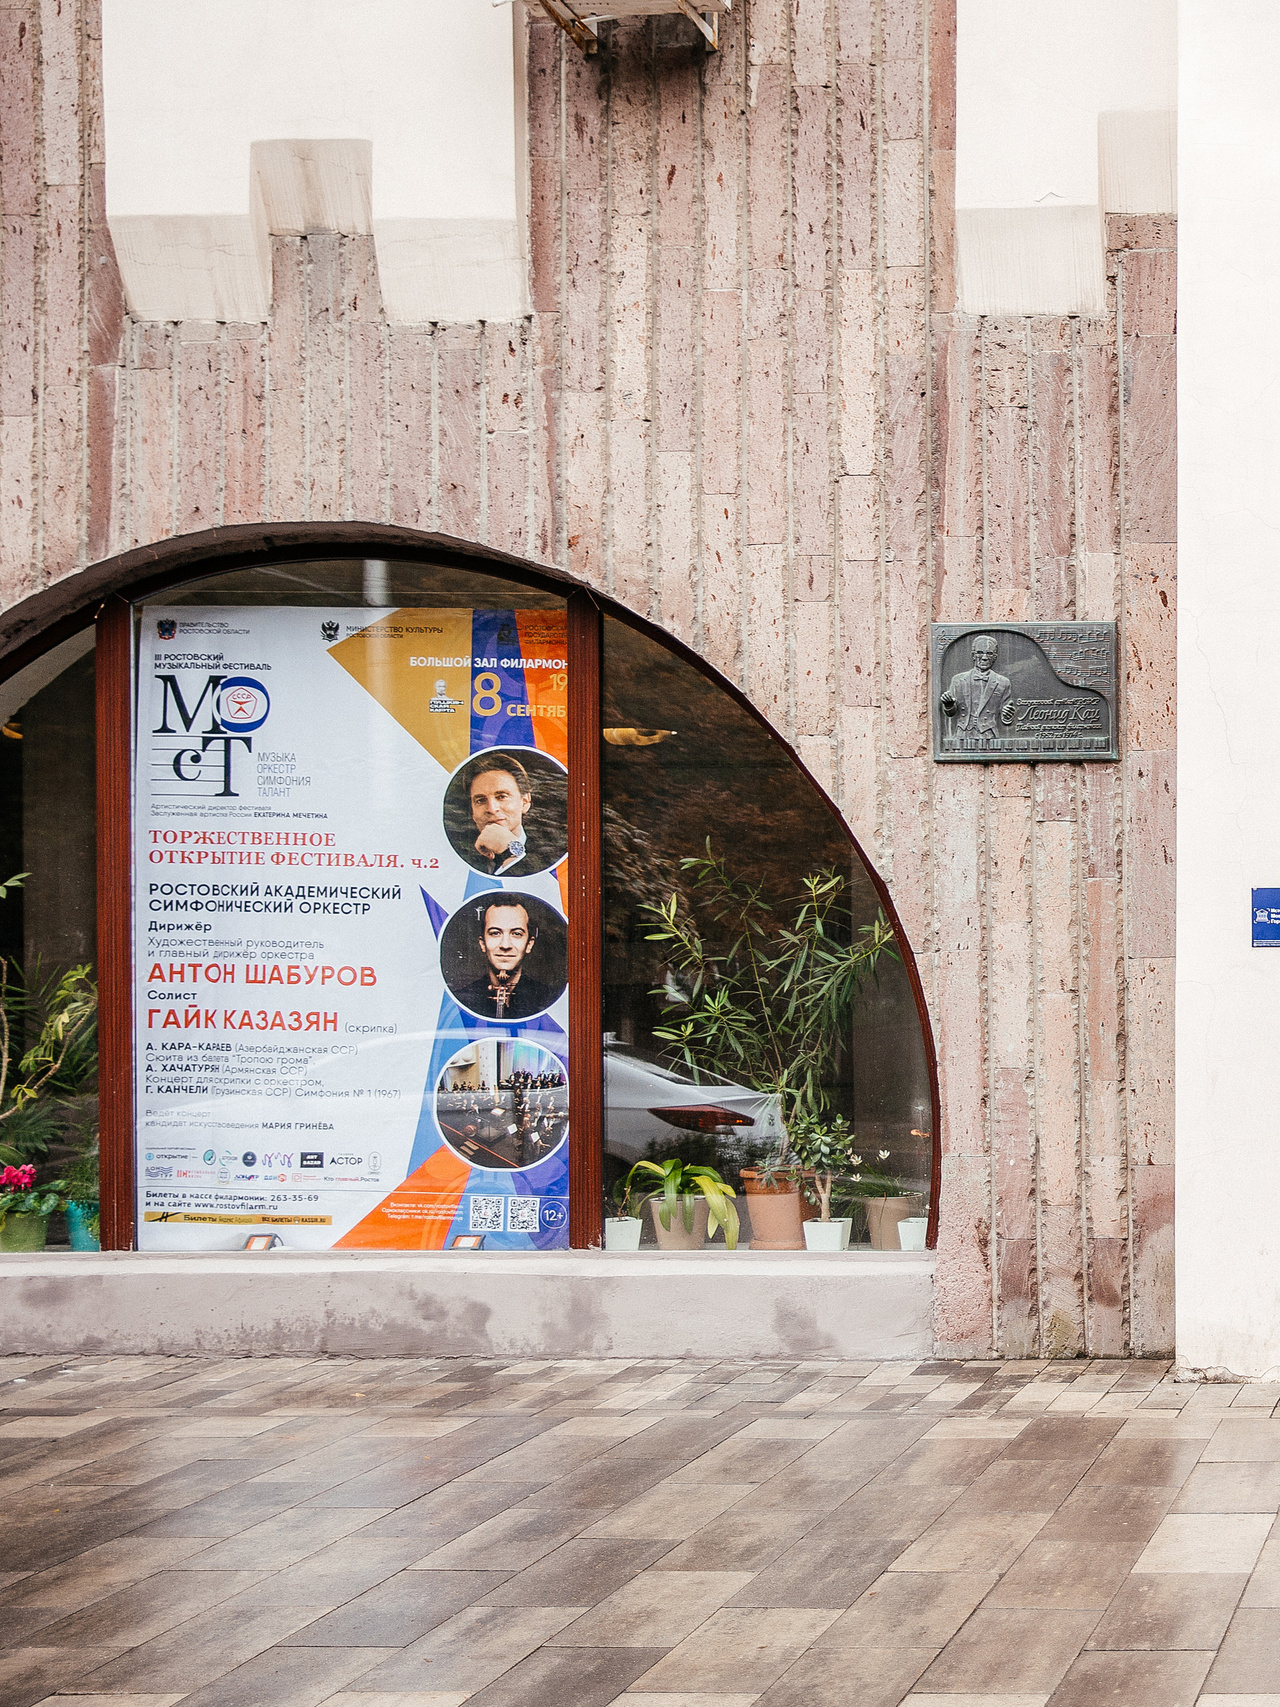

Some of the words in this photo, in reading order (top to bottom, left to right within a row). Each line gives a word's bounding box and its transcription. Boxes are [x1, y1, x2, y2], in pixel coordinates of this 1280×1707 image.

[164, 653, 224, 661] РОСТОВСКИЙ
[410, 656, 471, 668] БОЛЬШОЙ
[474, 658, 497, 668] ЗАЛ
[154, 662, 220, 670] МУЗЫКАЛЬНЫЙ
[472, 672, 502, 716] 8
[258, 752, 296, 762] МУЗЫКА
[257, 764, 296, 773] ОРКЕСТР
[257, 776, 311, 786] СИМФОНИЯ
[258, 787, 291, 797] ТАЛАНТ
[149, 830, 336, 846] ТОРЖЕСТВЕННОЕ
[149, 850, 266, 865] ОТКРЫТИЕ
[270, 851, 405, 868] ФЕСТИВАЛЯ.
[411, 858, 439, 868] ч.2
[149, 882, 260, 896] РОСТОВСКИЙ
[264, 884, 401, 900] АКАДЕМИЧЕСКИЙ
[149, 899, 293, 913] СИМФОНИЧЕСКИЙ
[299, 901, 371, 915] ОРКЕСТР
[148, 921, 212, 933] Дирижёр
[148, 936, 243, 949] Художественный
[246, 938, 324, 950] руководитель
[159, 950, 209, 958] главный
[213, 950, 257, 961] дирижёр
[260, 951, 315, 961] оркестра
[147, 963, 235, 983] АНТОН
[245, 964, 377, 987] ШАБУРОВ
[147, 990, 198, 1000] Солист
[148, 1004, 217, 1029] ГАЙК
[223, 1010, 338, 1032] КАЗАЗЯН
[344, 1023, 397, 1035] (скрипка)
[146, 1043, 157, 1051] А.
[161, 1043, 232, 1051] КАРА-КАРАЕВ
[235, 1043, 328, 1054] (Азербайджанская
[331, 1045, 358, 1055] ССР)
[146, 1053, 183, 1062] Сюита
[146, 1064, 157, 1072] А.
[161, 1064, 220, 1073] ХАЧАТУРЯН
[222, 1065, 276, 1074] (Армянская
[280, 1066, 307, 1076] ССР)
[146, 1075, 193, 1084] Концерт
[264, 1078, 324, 1087] оркестром,
[146, 1086, 153, 1094] Г.
[157, 1086, 208, 1094] КАНЧЕЛИ
[211, 1086, 262, 1096] (Грузинская
[265, 1087, 292, 1098] ССР)
[295, 1088, 350, 1098] Симфония
[353, 1089, 364, 1097] №
[374, 1089, 401, 1099] (1967)
[262, 1122, 292, 1130] МАРИЯ
[295, 1121, 334, 1130] ГРИНЁВА
[330, 1157, 363, 1165] АСТОР
[214, 1193, 267, 1203] филармонии:
[195, 1202, 278, 1210] www.rostovfilarm.ru
[544, 1210, 564, 1221] 12+
